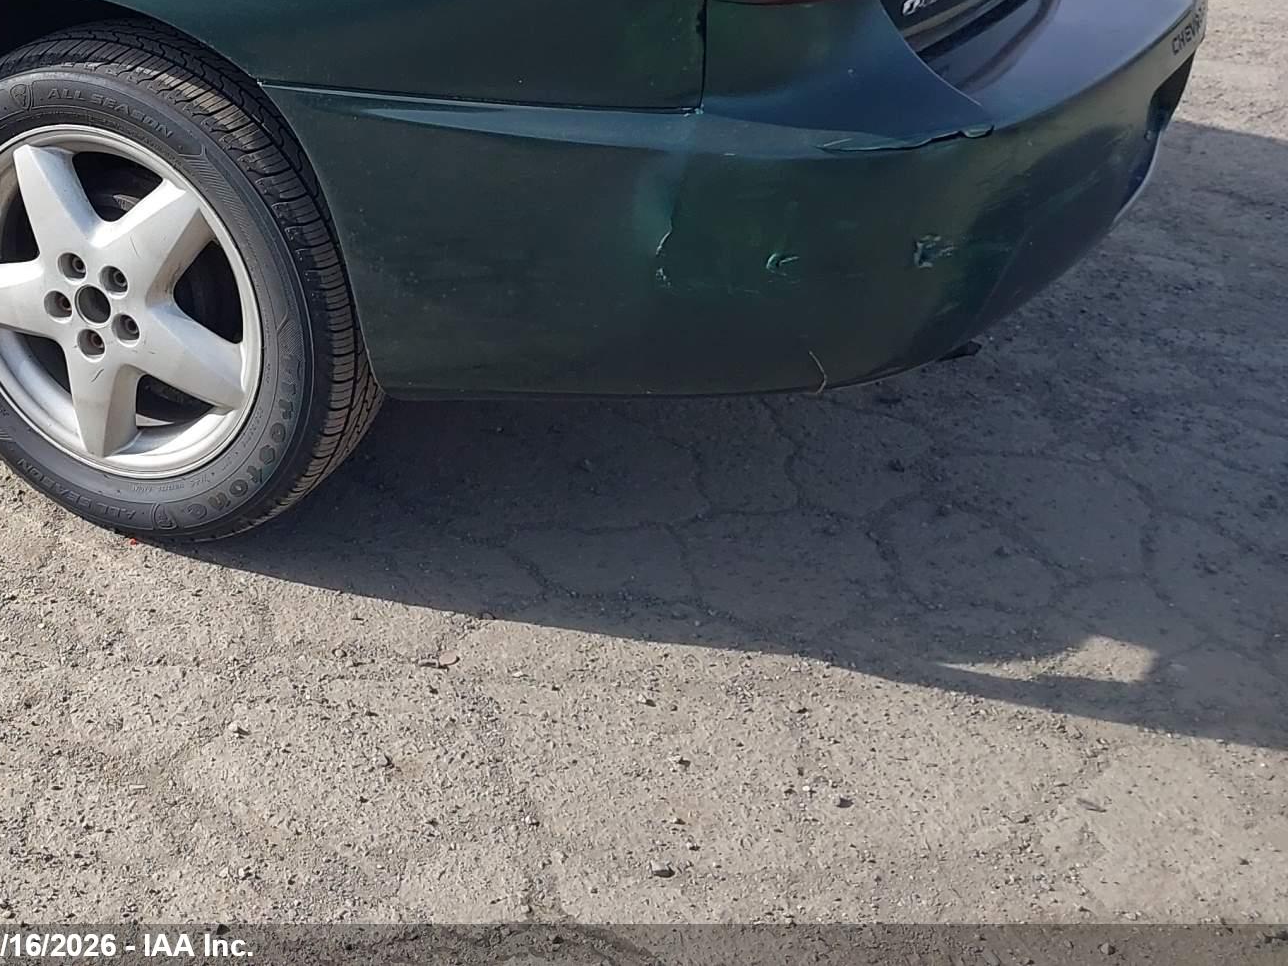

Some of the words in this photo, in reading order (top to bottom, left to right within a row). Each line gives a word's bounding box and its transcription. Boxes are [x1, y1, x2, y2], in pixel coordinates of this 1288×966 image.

[47, 88, 85, 101] ALL
[91, 93, 174, 139] SEASON
[96, 503, 137, 520] ALL
